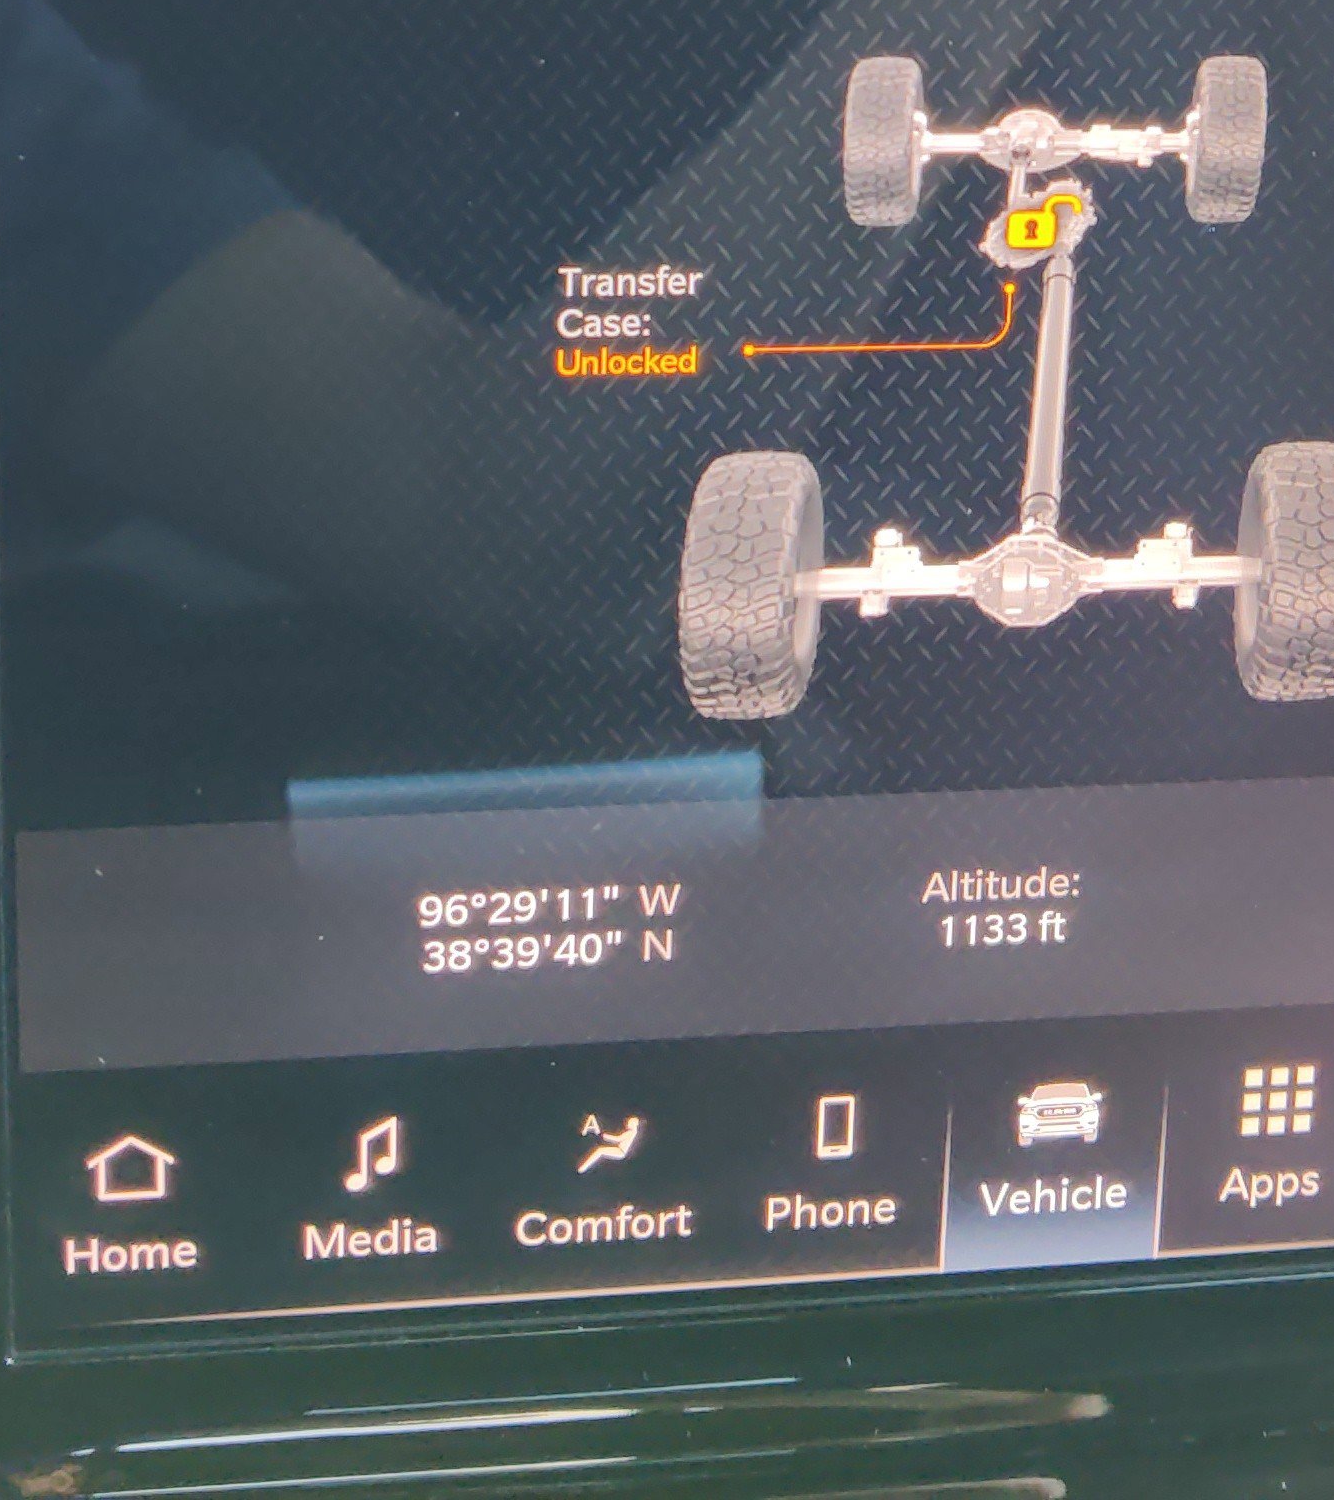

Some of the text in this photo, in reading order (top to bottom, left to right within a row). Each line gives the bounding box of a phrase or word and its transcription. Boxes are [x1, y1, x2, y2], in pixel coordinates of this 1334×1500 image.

[557, 264, 704, 297] Transfer
[557, 308, 651, 338] Case:
[556, 345, 698, 376] Unlocked
[639, 883, 681, 916] W
[921, 866, 1081, 904] Altitude:
[642, 928, 673, 962] N
[940, 910, 1067, 947] 1133 ft
[979, 1174, 1128, 1217] Vehicle
[1219, 1166, 1321, 1209] Apps
[515, 1204, 693, 1247] Comfort
[765, 1193, 897, 1232] Phone
[65, 1236, 199, 1275] Home
[303, 1218, 439, 1261] Media
